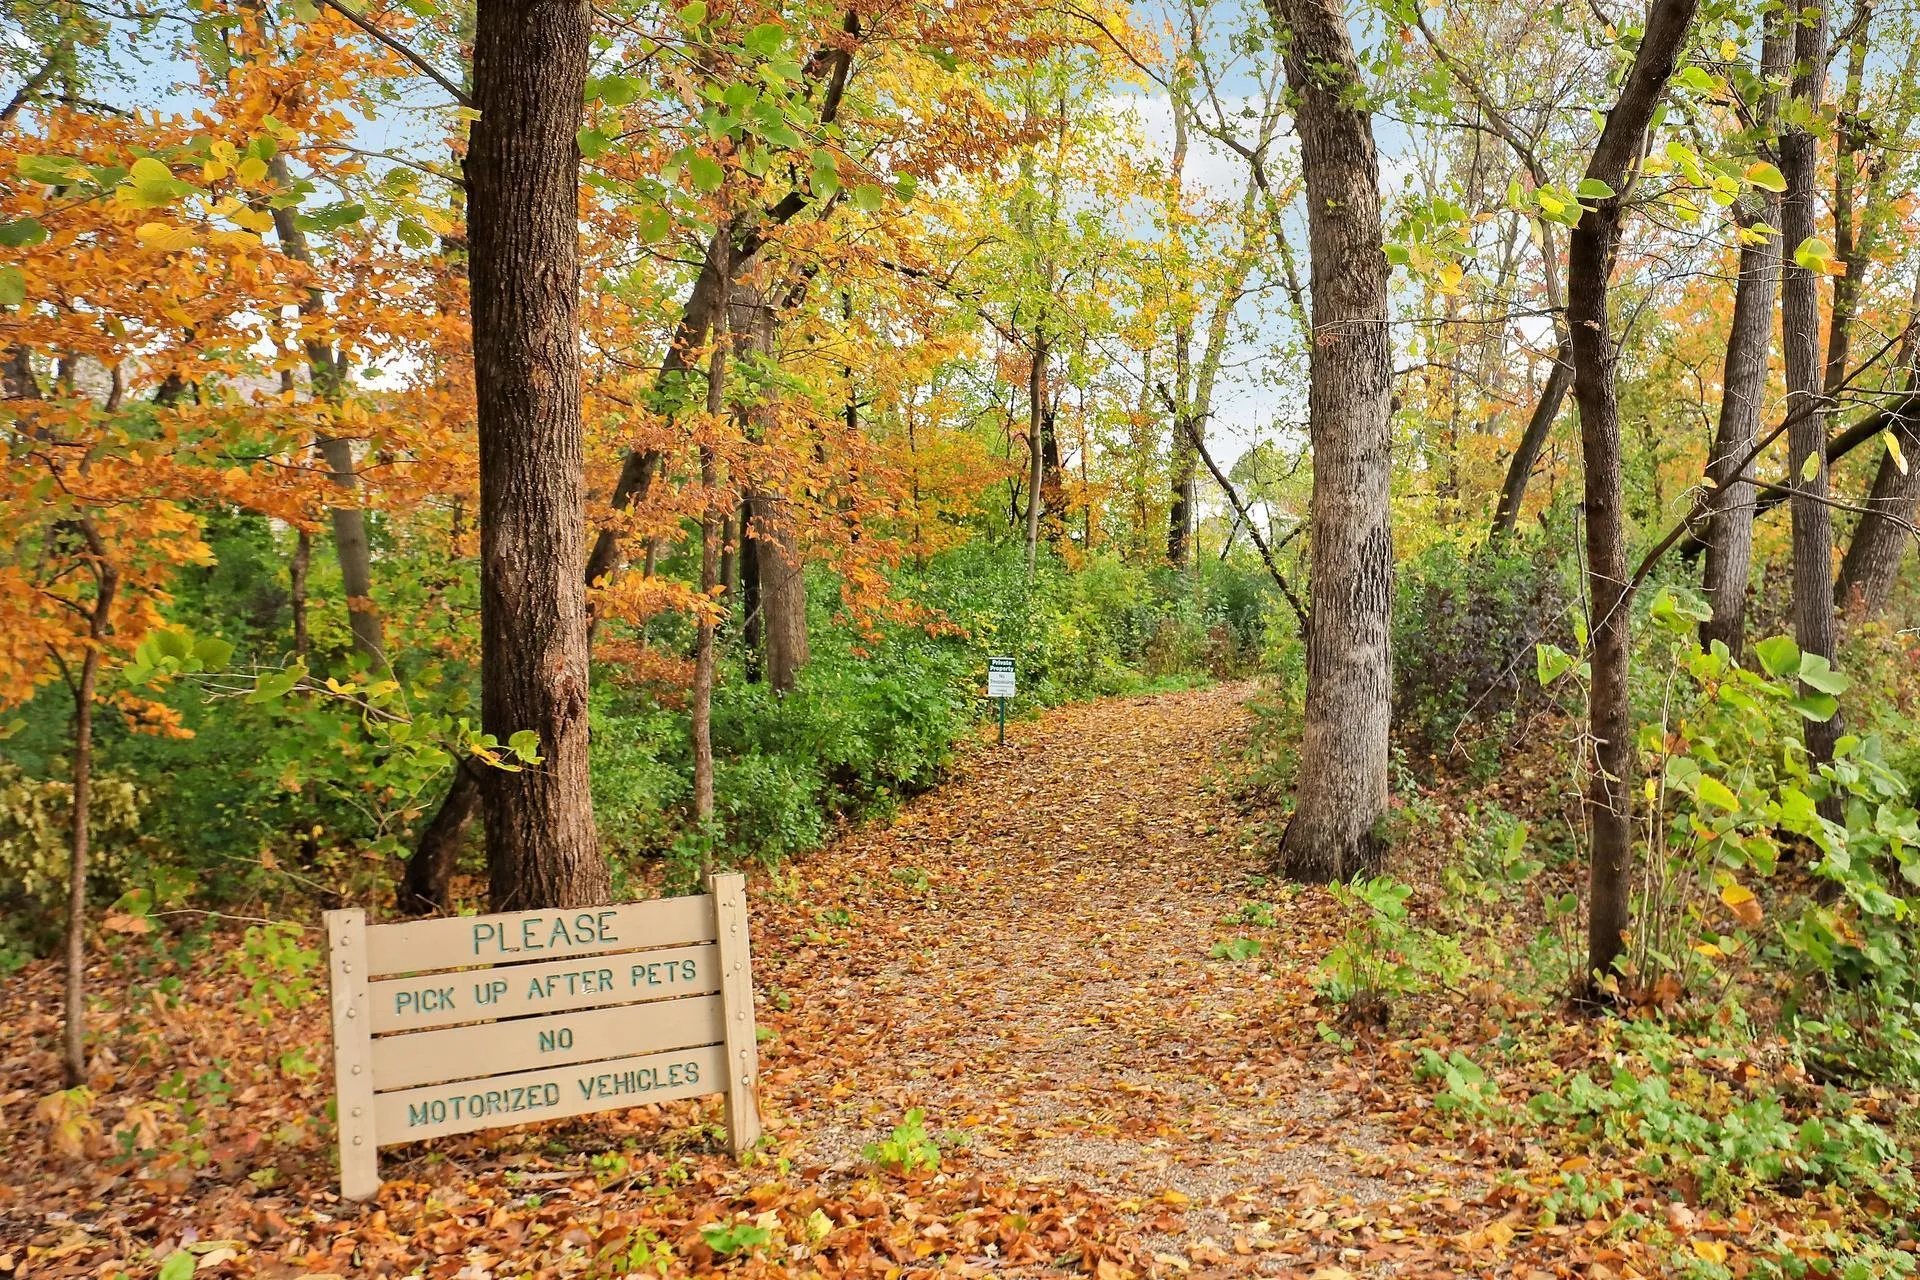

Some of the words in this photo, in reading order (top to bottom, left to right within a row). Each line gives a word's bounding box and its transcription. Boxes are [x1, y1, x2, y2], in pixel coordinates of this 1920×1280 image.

[472, 911, 618, 955] PLEASE
[394, 986, 456, 1016] PICK
[474, 980, 508, 1006] UP
[527, 969, 614, 1001] AFTER
[631, 959, 697, 986] PETS
[538, 1028, 574, 1053] NO
[407, 1082, 560, 1128] MOTORIZED
[578, 1061, 700, 1100] VEHICLES
